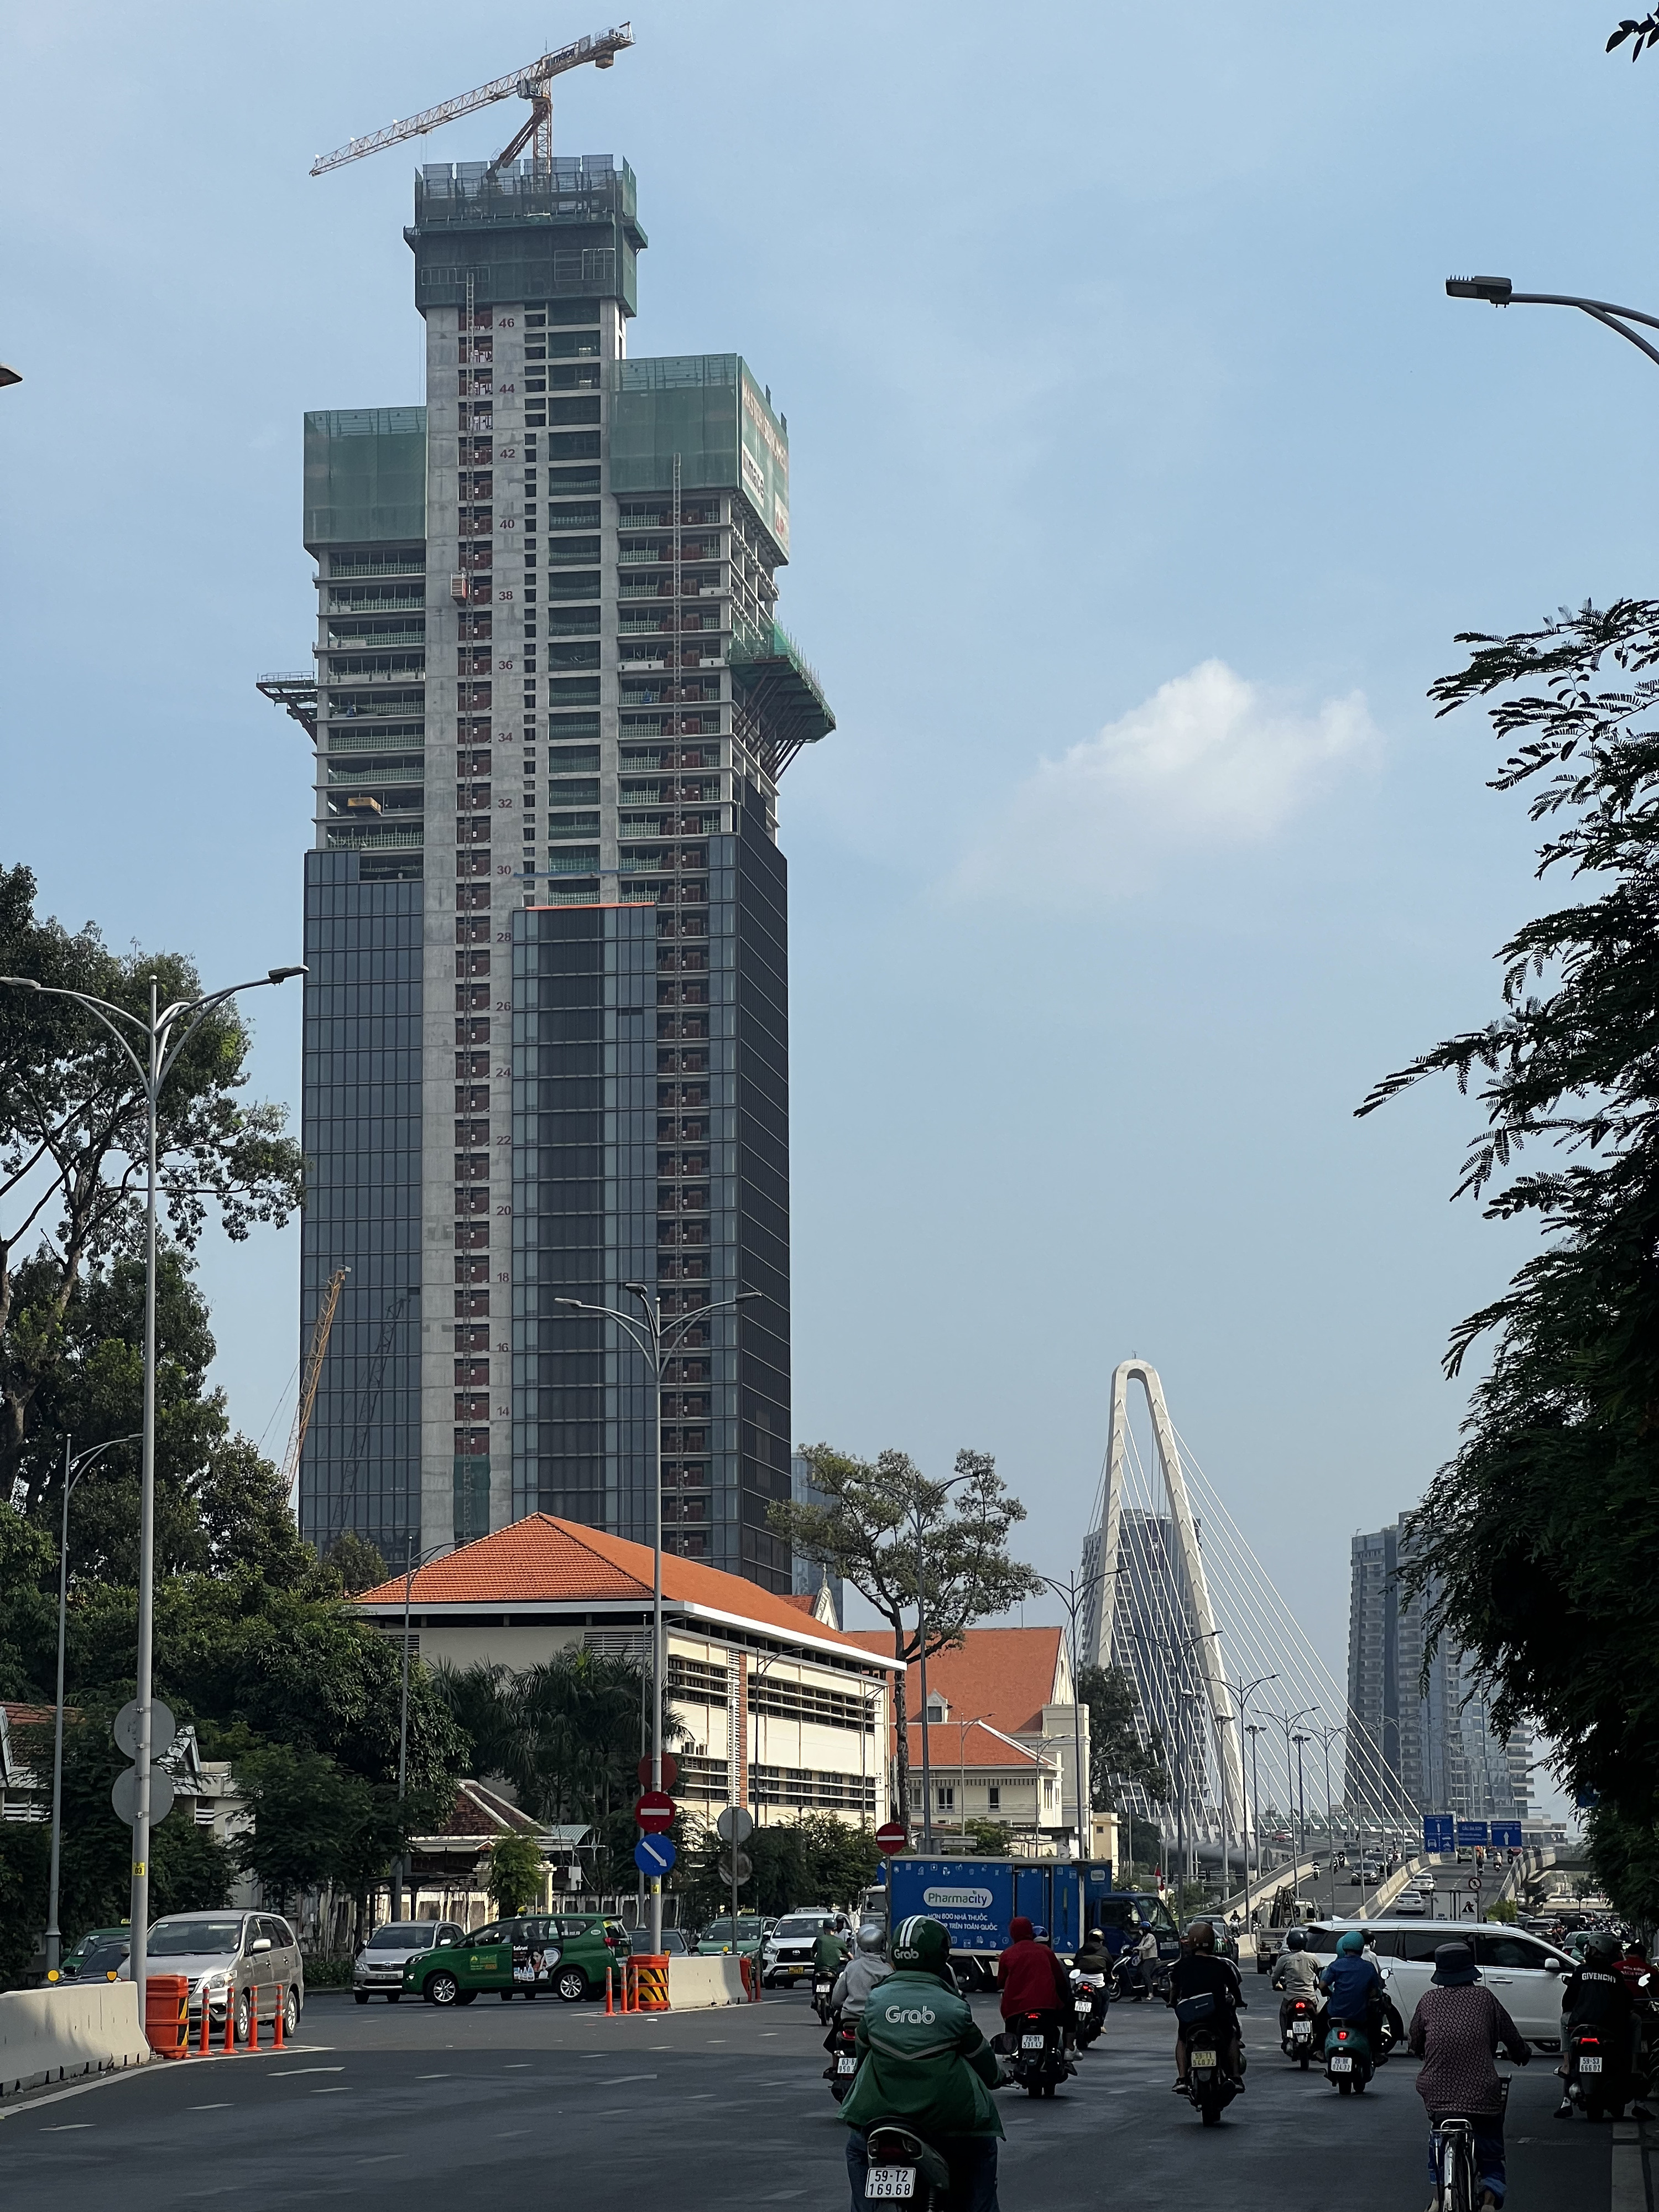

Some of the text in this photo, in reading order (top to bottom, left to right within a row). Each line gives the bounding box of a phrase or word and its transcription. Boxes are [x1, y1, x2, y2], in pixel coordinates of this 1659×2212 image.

[498, 317, 515, 328] 46
[499, 383, 515, 394] 44
[500, 448, 515, 458] 42
[499, 519, 515, 529] 40
[499, 591, 513, 601] 38
[498, 660, 513, 670] 36
[498, 732, 513, 742] 34
[498, 799, 512, 808] 32
[497, 865, 512, 875] 30
[497, 932, 512, 942] 28
[496, 1001, 511, 1011] 26
[496, 1067, 512, 1077] 24
[497, 1135, 512, 1145] 22
[497, 1206, 511, 1215] 20
[497, 1272, 509, 1282] 18
[496, 1343, 509, 1353] 16
[497, 1406, 509, 1416] 14
[928, 1891, 987, 1906] Pharmacity
[894, 1948, 919, 1959] Grab
[1582, 1972, 1616, 1983] GIVENCHY
[885, 2005, 936, 2025] Grab
[875, 2170, 908, 2182] 59-T2
[870, 2183, 911, 2195] 169.68
